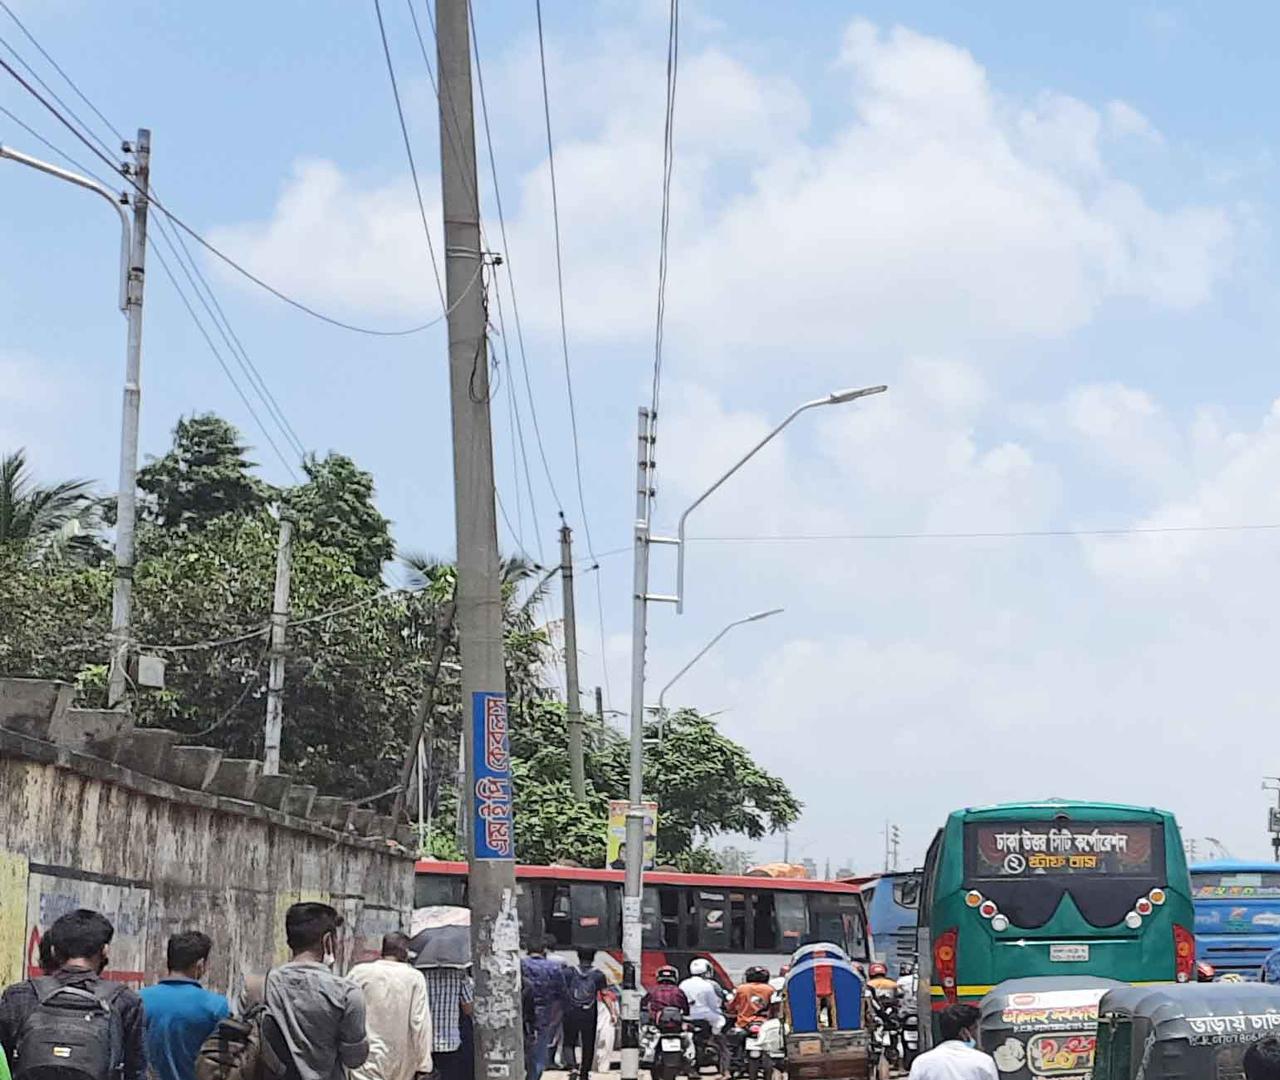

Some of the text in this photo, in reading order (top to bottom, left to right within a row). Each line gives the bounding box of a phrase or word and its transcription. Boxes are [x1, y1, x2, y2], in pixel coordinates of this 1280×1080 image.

[476, 698, 511, 855] এমইপি কেবলস
[994, 828, 1128, 852] ঢাকা উত্তর সিটি কর্পোরেশন
[1068, 855, 1096, 868] বাস
[1186, 1016, 1246, 1035] ভাড়ায়
